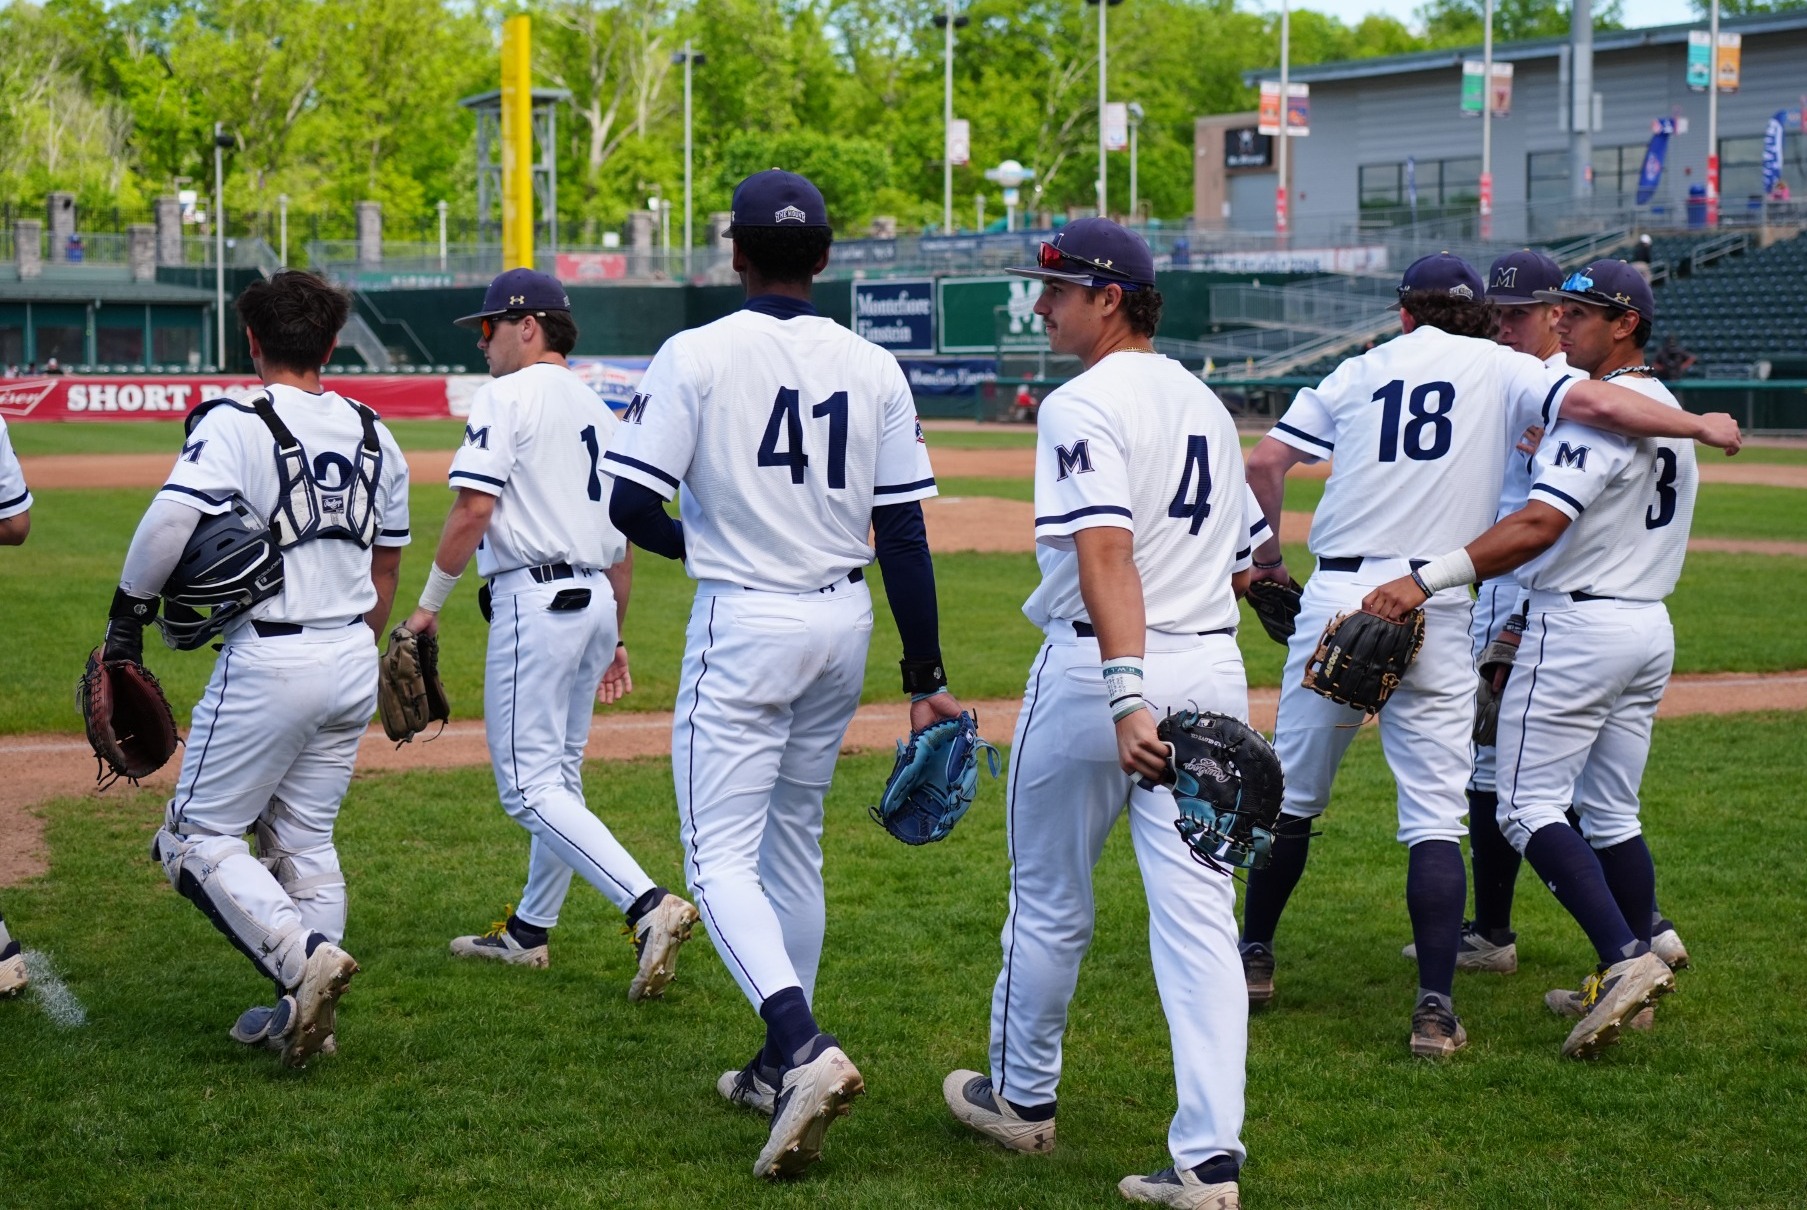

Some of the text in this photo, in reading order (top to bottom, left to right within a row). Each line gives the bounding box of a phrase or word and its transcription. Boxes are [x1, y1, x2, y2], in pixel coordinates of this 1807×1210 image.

[1490, 267, 1517, 288] M
[67, 384, 192, 412] SHORT
[461, 423, 490, 451] M
[757, 386, 849, 490] 41
[1371, 379, 1456, 463] 18
[579, 424, 602, 502] 1
[1054, 439, 1096, 483] M
[1552, 440, 1592, 473] M
[1167, 434, 1212, 536] 4
[1645, 446, 1677, 530] 3
[1324, 645, 1341, 678] A2000
[1182, 758, 1231, 783] Rawlings
